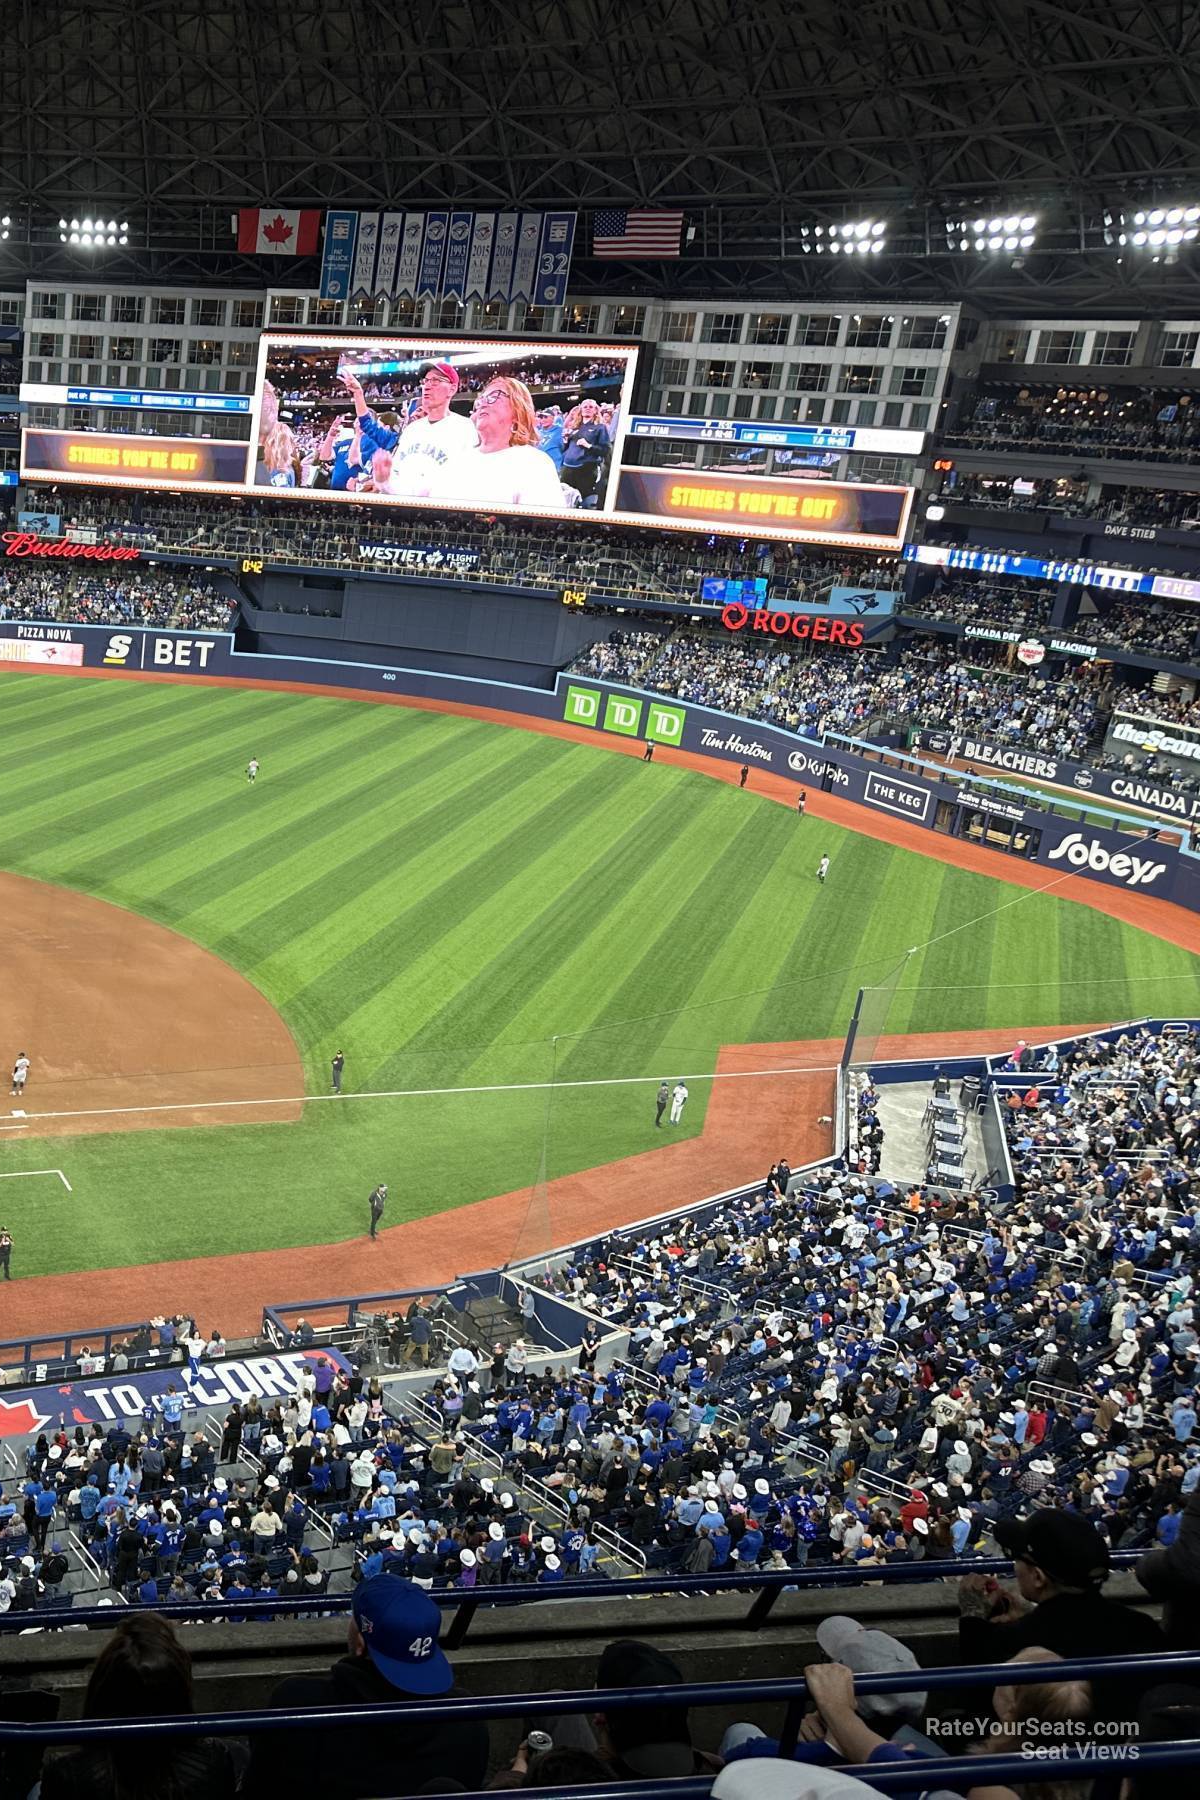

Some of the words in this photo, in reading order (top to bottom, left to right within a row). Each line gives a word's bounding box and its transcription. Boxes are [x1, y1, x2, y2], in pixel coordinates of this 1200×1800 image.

[360, 243, 375, 255] 1985
[404, 244, 418, 256] 1991
[426, 244, 441, 256] 1992
[450, 245, 467, 257] 1993
[472, 245, 490, 257] 2015
[495, 245, 513, 257] 2016
[540, 252, 568, 275] 32
[68, 445, 120, 465] STRIKES
[122, 449, 169, 469] YOU'RE
[170, 453, 198, 471] OUT
[671, 486, 735, 511] STRIKES
[737, 491, 797, 516] YOU'RE
[800, 497, 837, 520] OUT
[1105, 525, 1127, 537] DAVE
[1130, 528, 1156, 540] STIEB
[1, 531, 141, 561] Budweiser
[242, 560, 264, 574] 0:42
[446, 553, 478, 564] FLIGHT
[562, 590, 587, 605] 0:42
[1161, 582, 1194, 596] THE
[17, 625, 45, 639] PIZZA
[46, 628, 73, 642] NOVA
[753, 609, 865, 647] ROGERS
[964, 625, 1001, 640] CANADA
[1002, 631, 1022, 642] DRY
[154, 638, 215, 667] BET
[1050, 639, 1098, 656] BLEACHERS
[382, 673, 396, 681] 400
[570, 692, 597, 718] TD
[611, 701, 638, 727] TD
[653, 710, 681, 737] TD
[701, 728, 723, 750] Tim
[724, 733, 774, 762] Hortons
[964, 742, 1059, 779] BLEACHERS
[807, 758, 850, 787] Kubota
[873, 783, 895, 800] THE
[898, 792, 921, 808] KEG
[957, 791, 980, 805] Active
[1110, 779, 1186, 814] CANADA
[1048, 833, 1167, 885] Sobeys
[84, 1384, 141, 1420] TO
[182, 1352, 308, 1406] CORE
[938, 1406, 952, 1417] 30
[998, 1467, 1012, 1477] 47
[408, 1637, 433, 1657] 42
